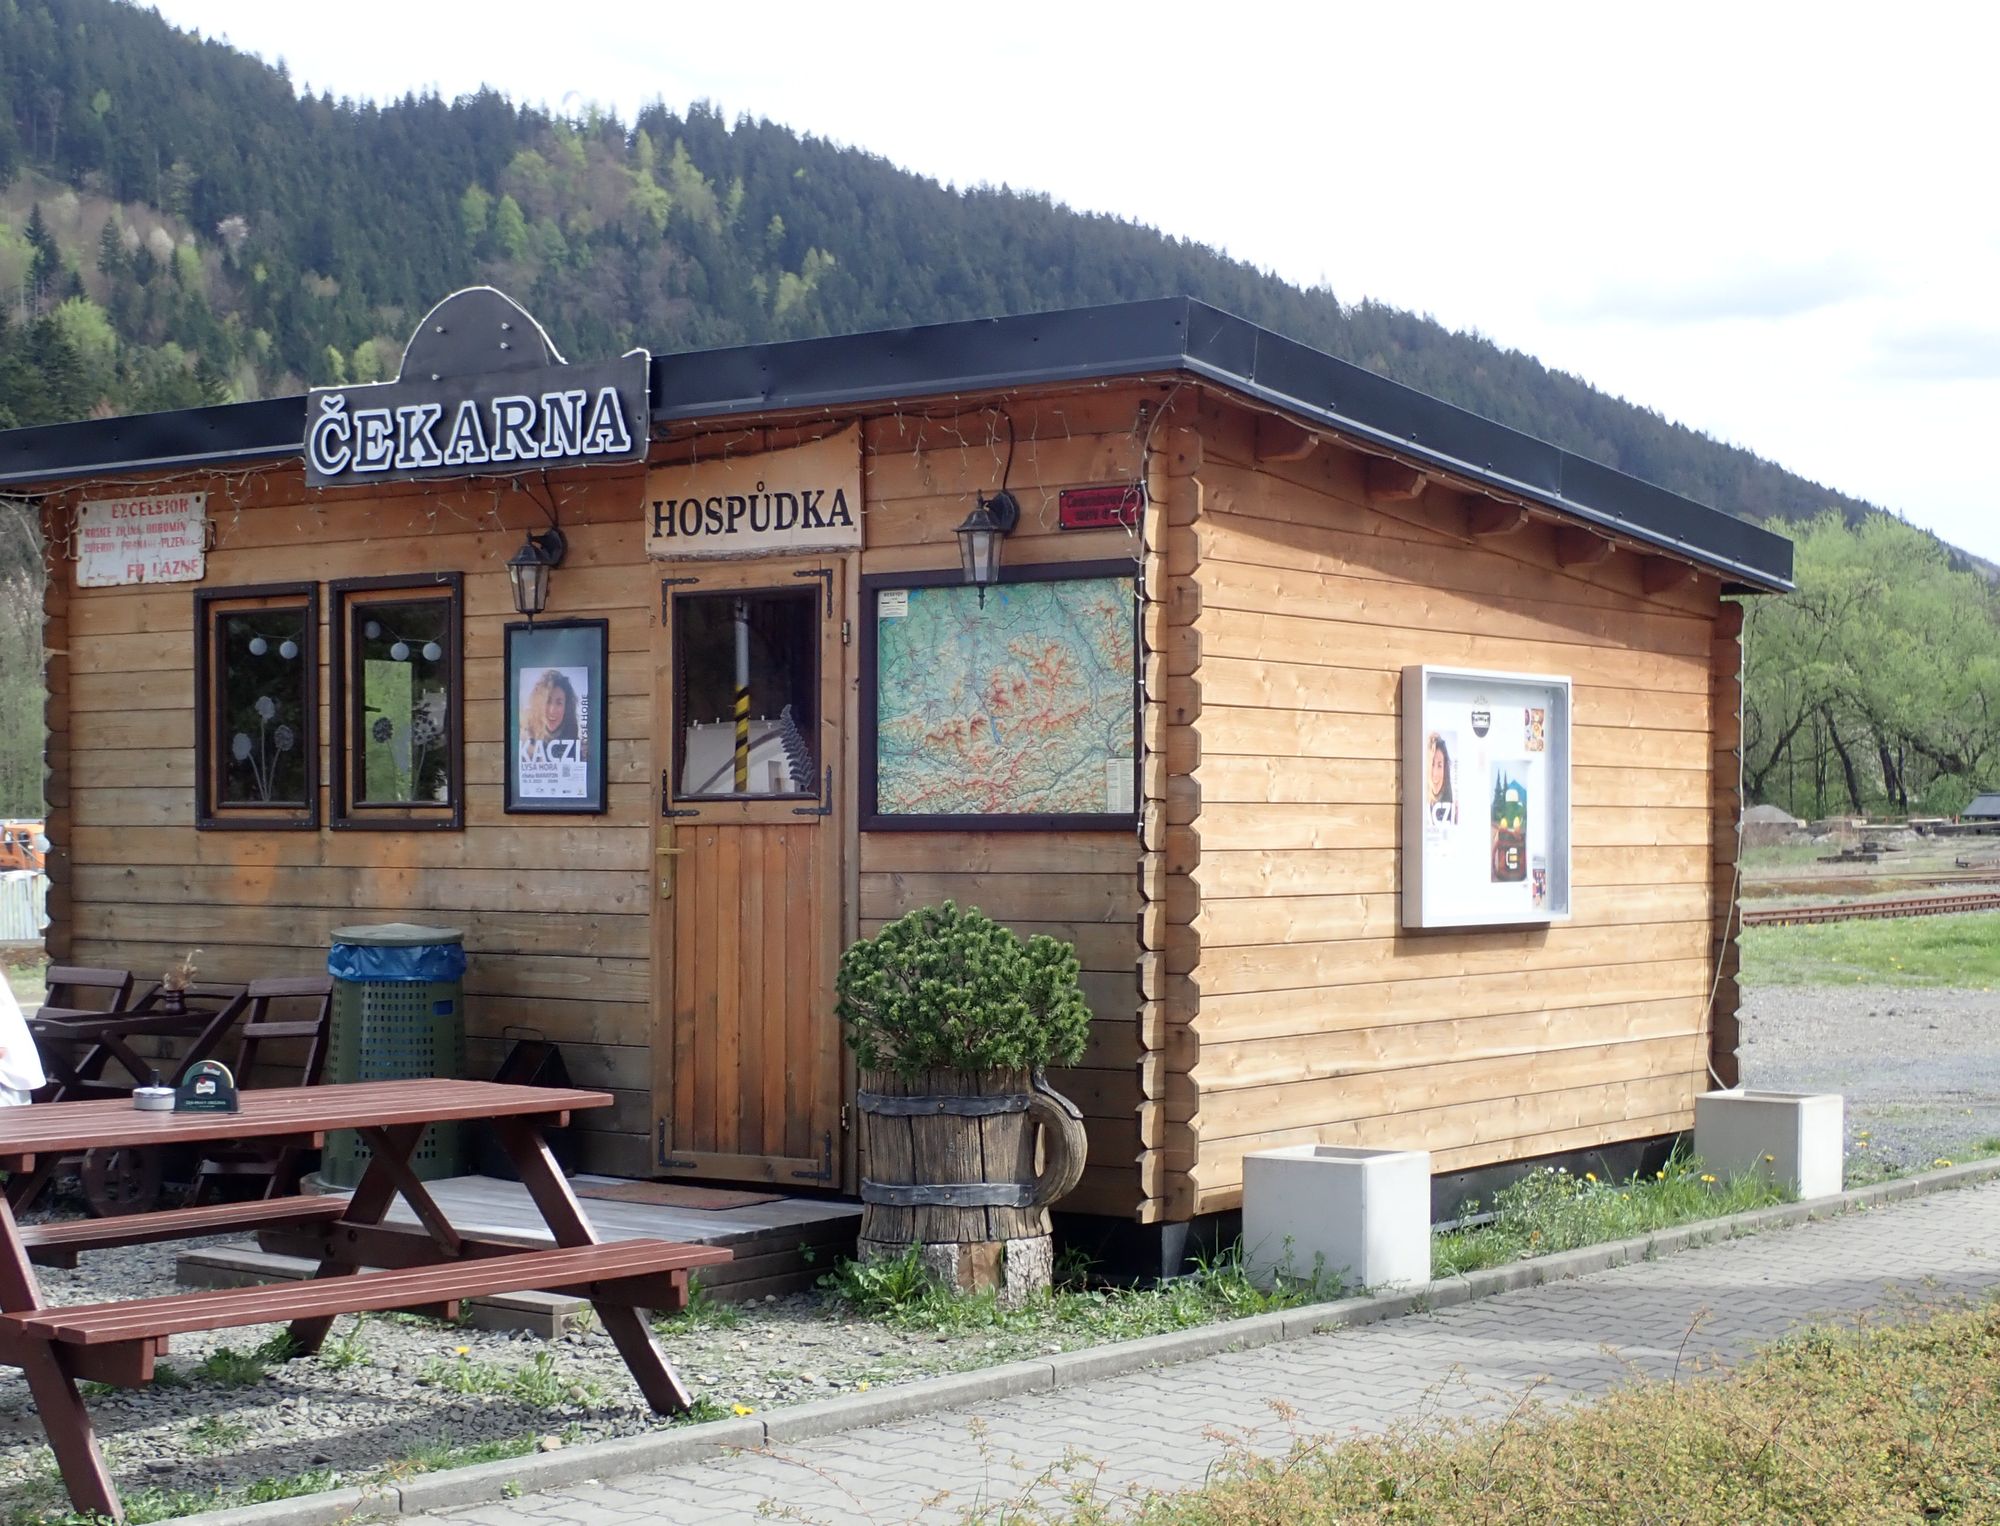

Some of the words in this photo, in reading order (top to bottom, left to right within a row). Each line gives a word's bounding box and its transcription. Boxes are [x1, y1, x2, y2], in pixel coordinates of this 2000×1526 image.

[310, 387, 631, 475] ČEKARNA
[111, 498, 189, 519] EXCELSIOR
[652, 481, 853, 538] HOSPŮDKA
